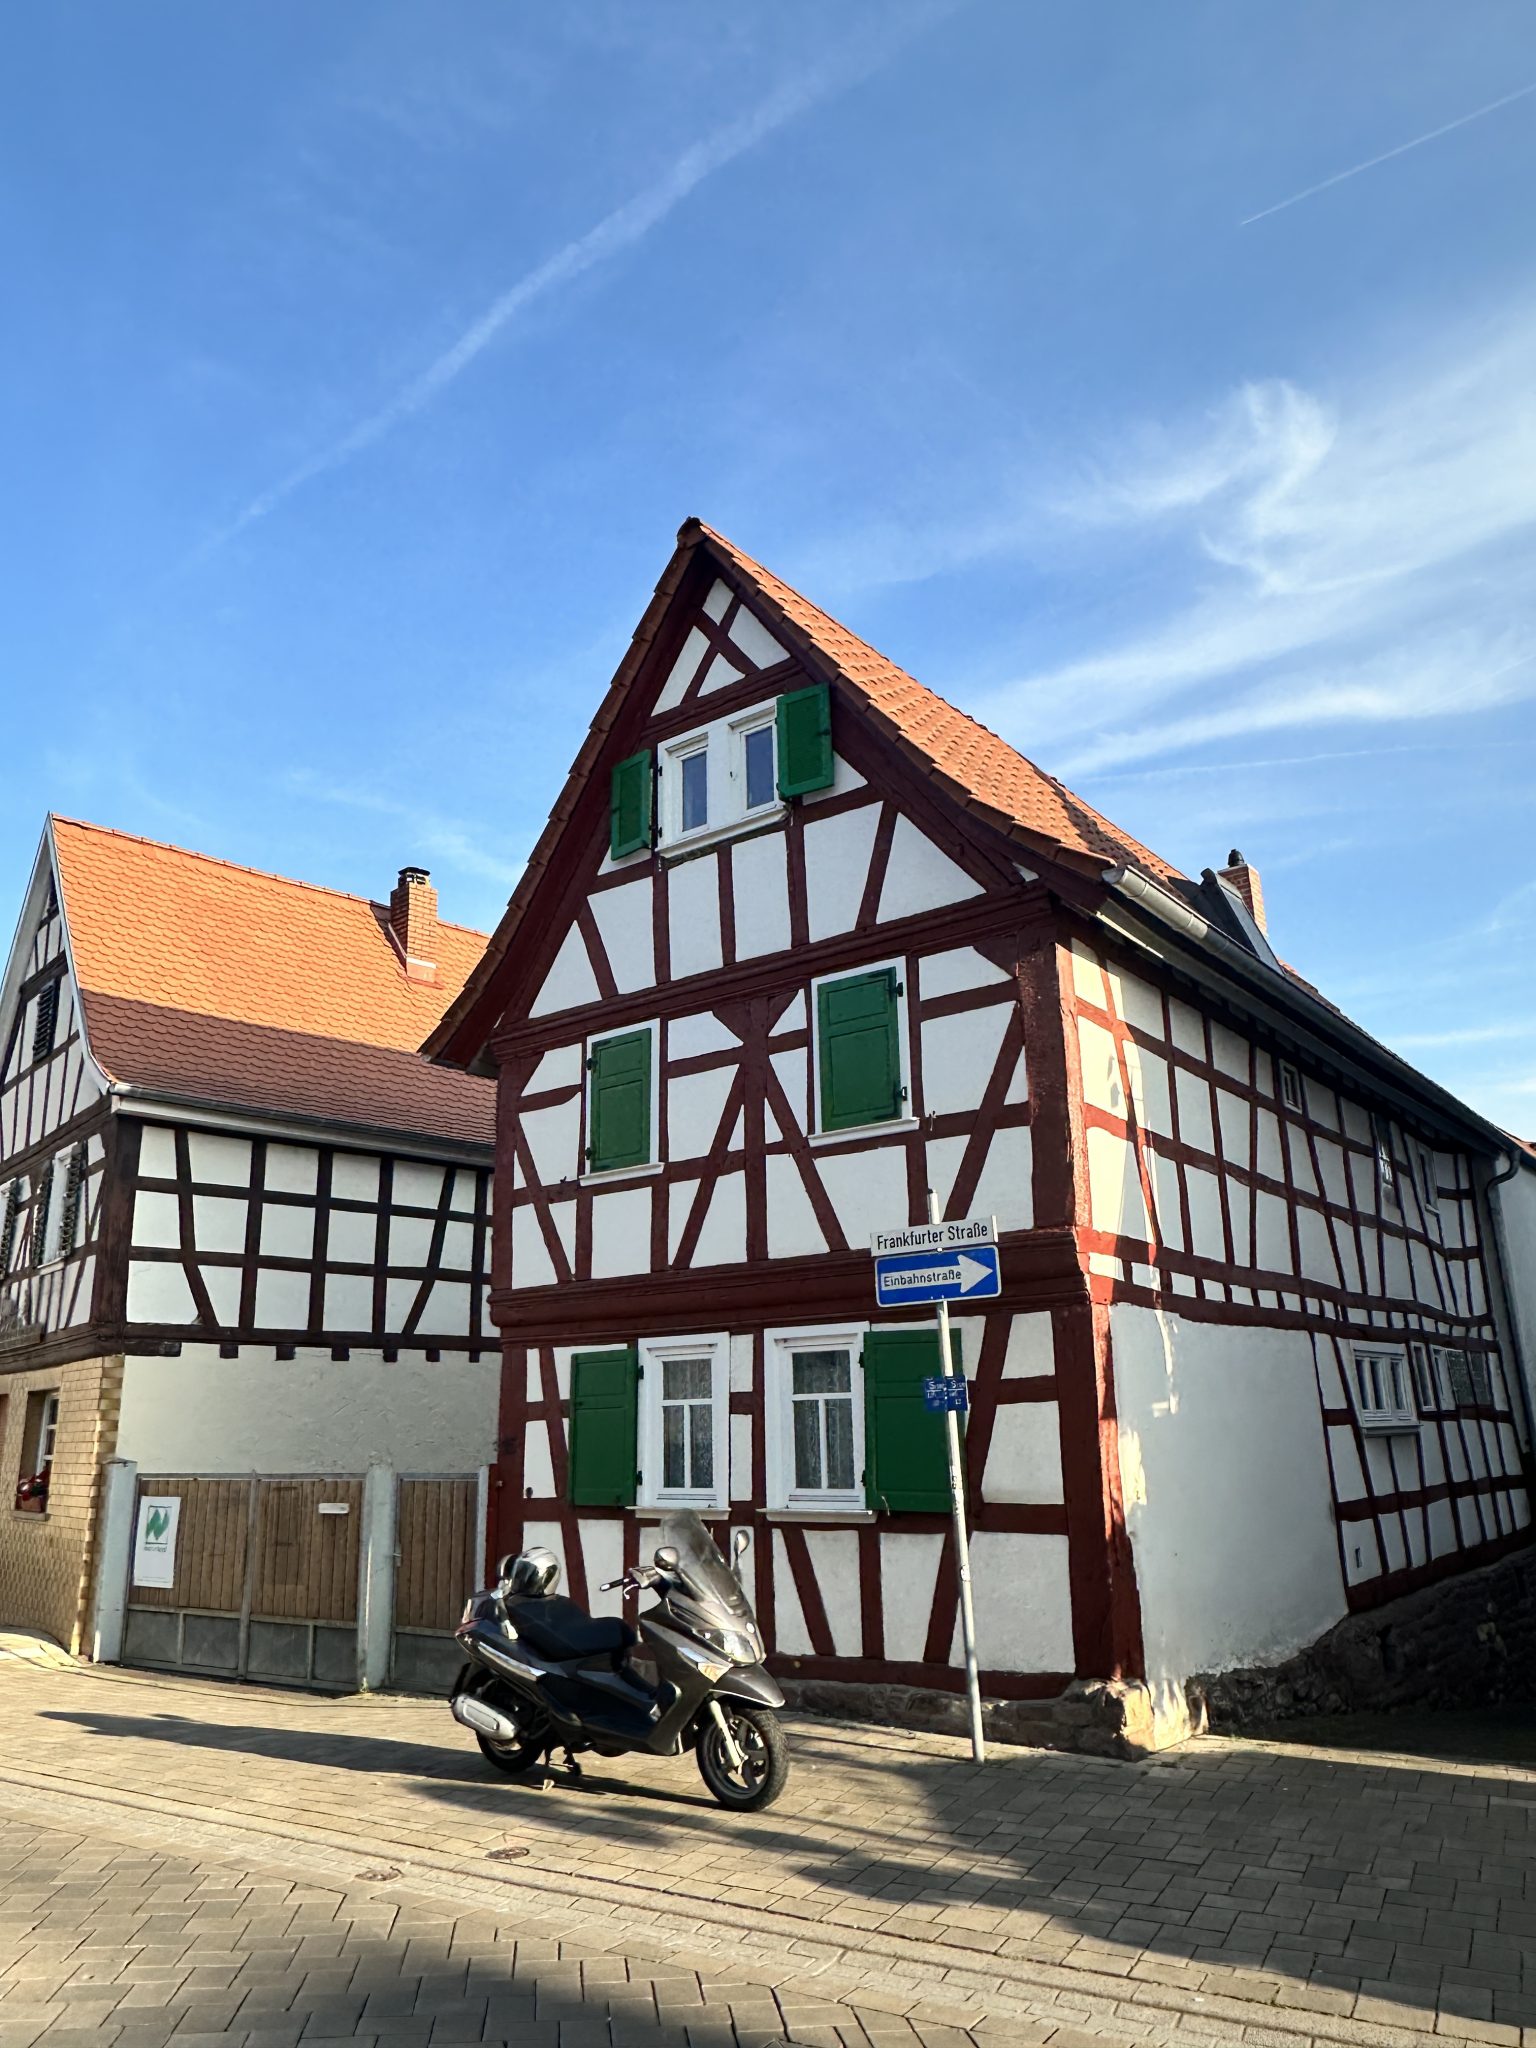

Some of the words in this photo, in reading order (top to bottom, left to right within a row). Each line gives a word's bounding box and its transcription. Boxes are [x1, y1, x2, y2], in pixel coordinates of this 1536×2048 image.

[877, 1230, 944, 1250] Frankfurter
[948, 1222, 988, 1241] Straße
[884, 1269, 962, 1287] Einbahnstraße
